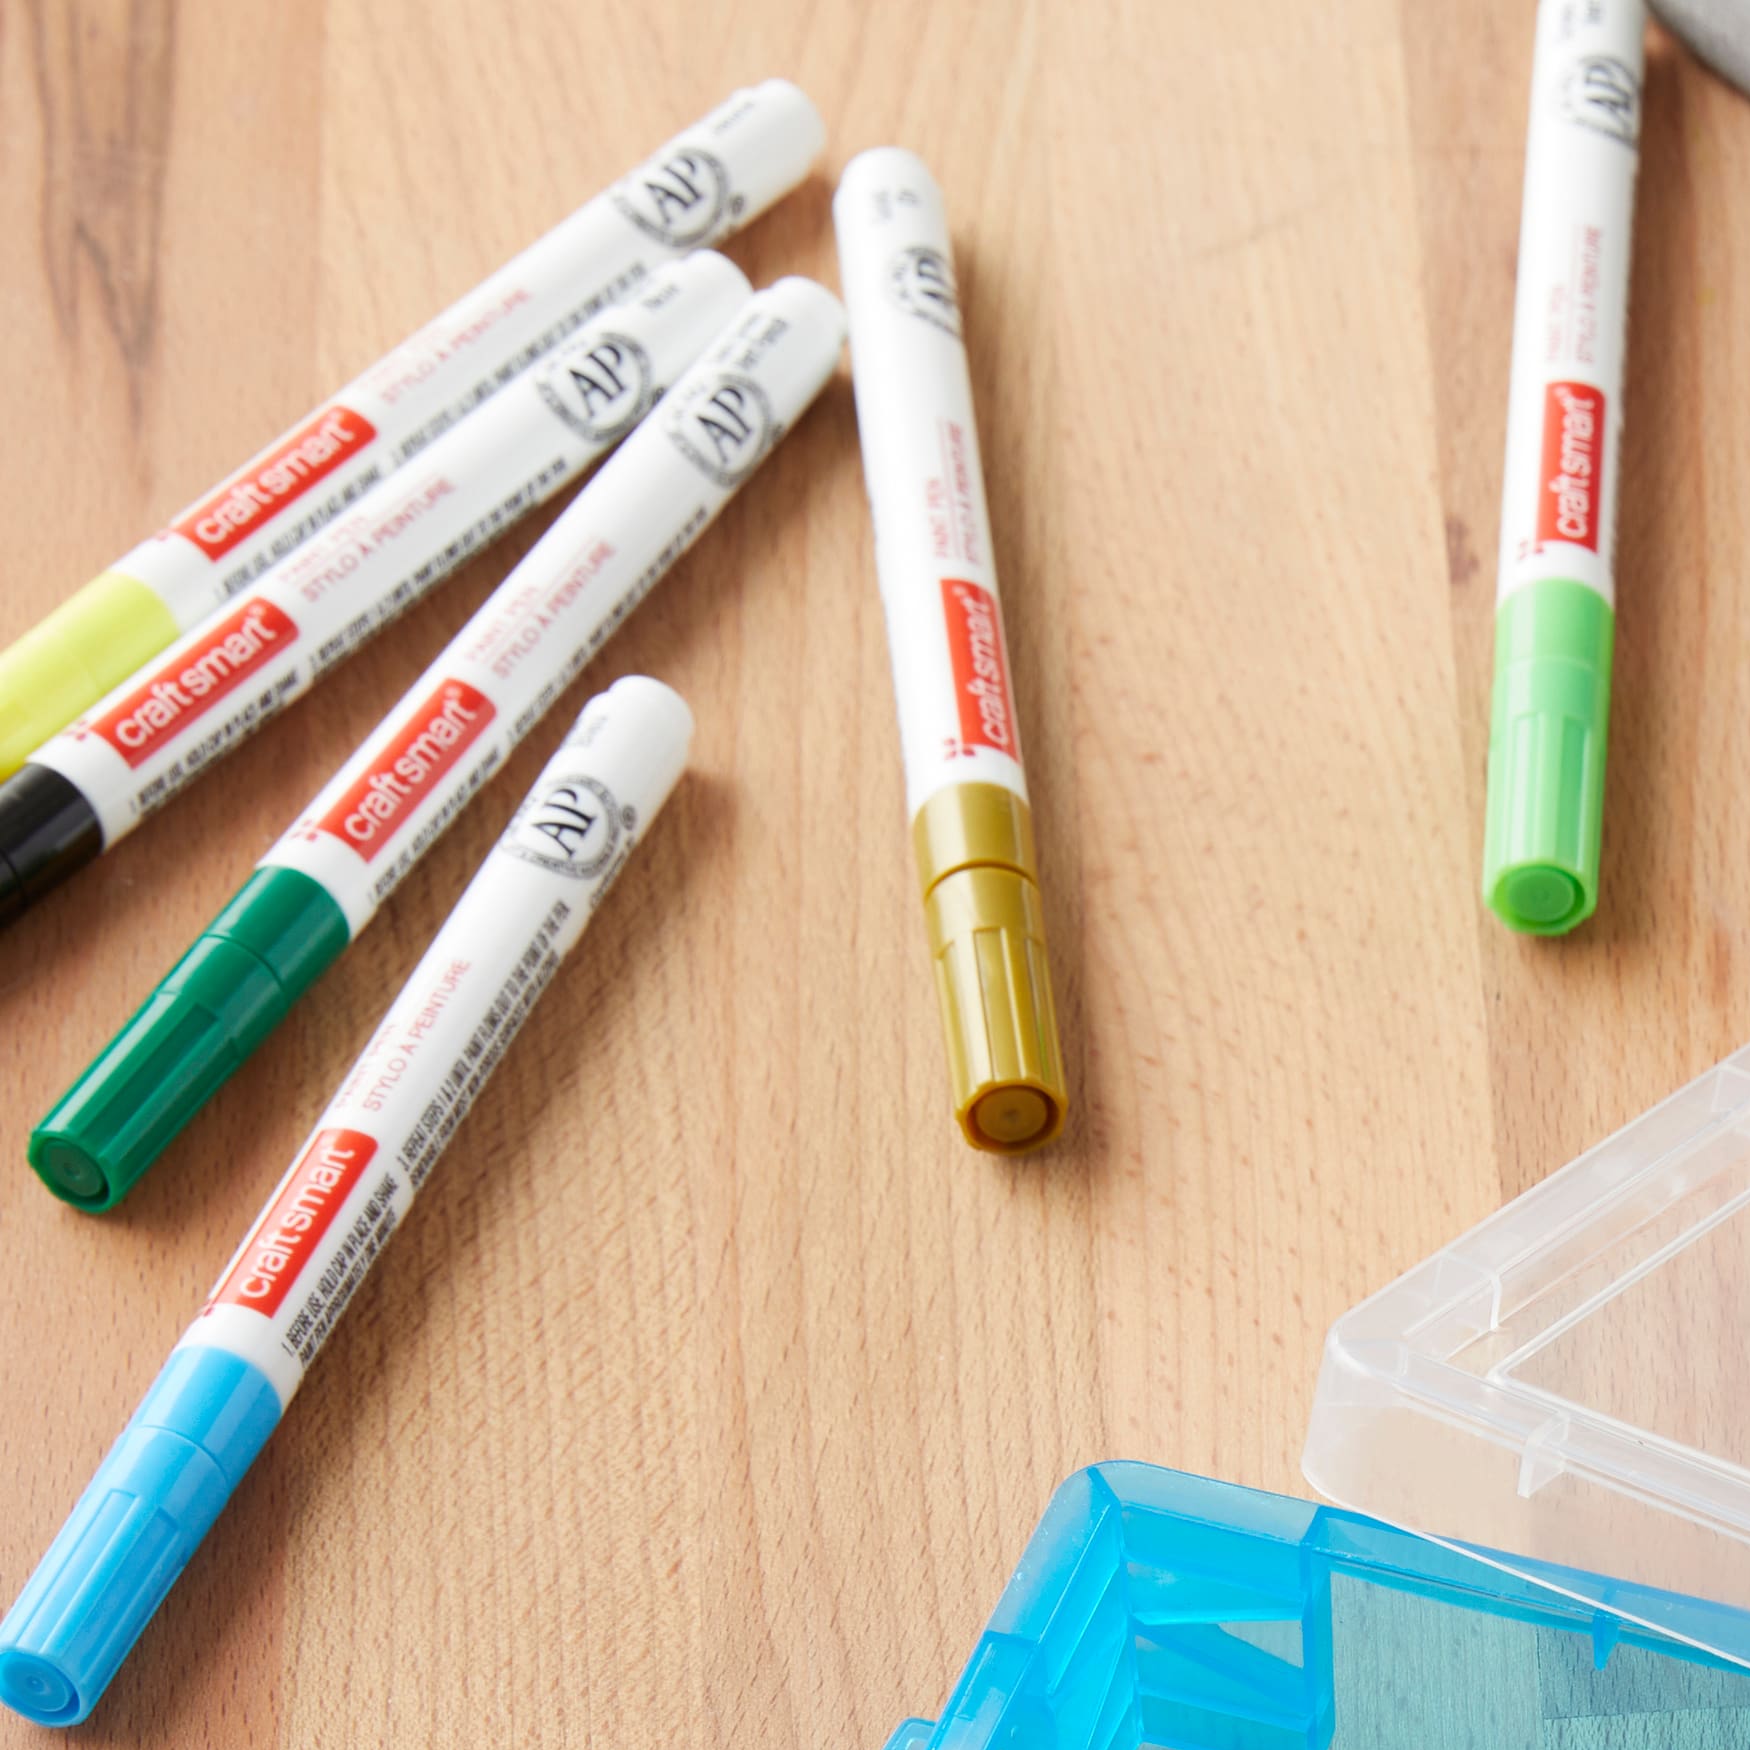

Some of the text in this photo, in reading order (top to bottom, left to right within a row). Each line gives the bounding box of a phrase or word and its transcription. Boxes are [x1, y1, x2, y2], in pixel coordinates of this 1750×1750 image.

[644, 154, 704, 224] AP
[569, 348, 628, 419] AP
[695, 385, 752, 464] AP
[298, 549, 362, 605] STYLO
[489, 624, 544, 682] STYLO
[112, 684, 193, 747] craft
[342, 777, 414, 840] craft
[531, 789, 596, 858] AP
[361, 1054, 409, 1115] STYLO
[406, 955, 472, 1043] PEINTURE
[237, 1238, 300, 1295] craft
